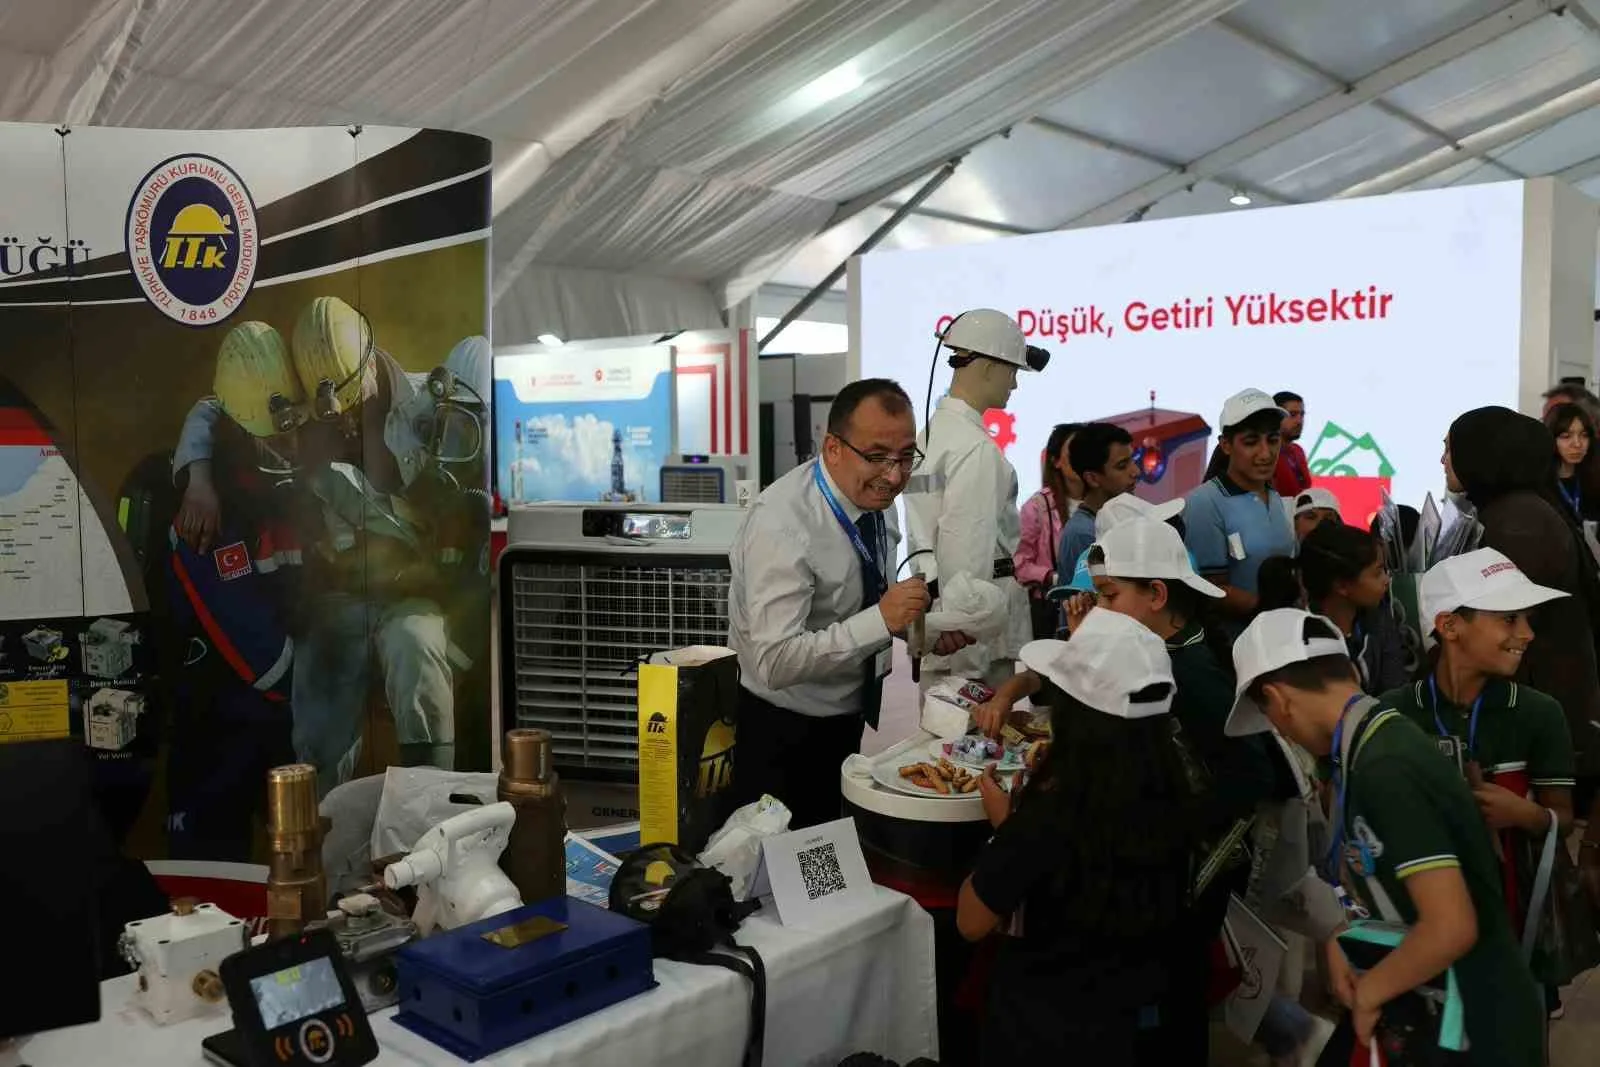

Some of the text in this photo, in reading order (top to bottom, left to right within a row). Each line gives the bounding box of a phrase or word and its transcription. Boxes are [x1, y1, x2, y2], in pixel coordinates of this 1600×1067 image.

[169, 163, 227, 184] KURUMU
[226, 183, 249, 225] GENEL
[1018, 285, 1393, 343] Düşük, Getiri Yüksektir
[591, 807, 640, 818] GENER
